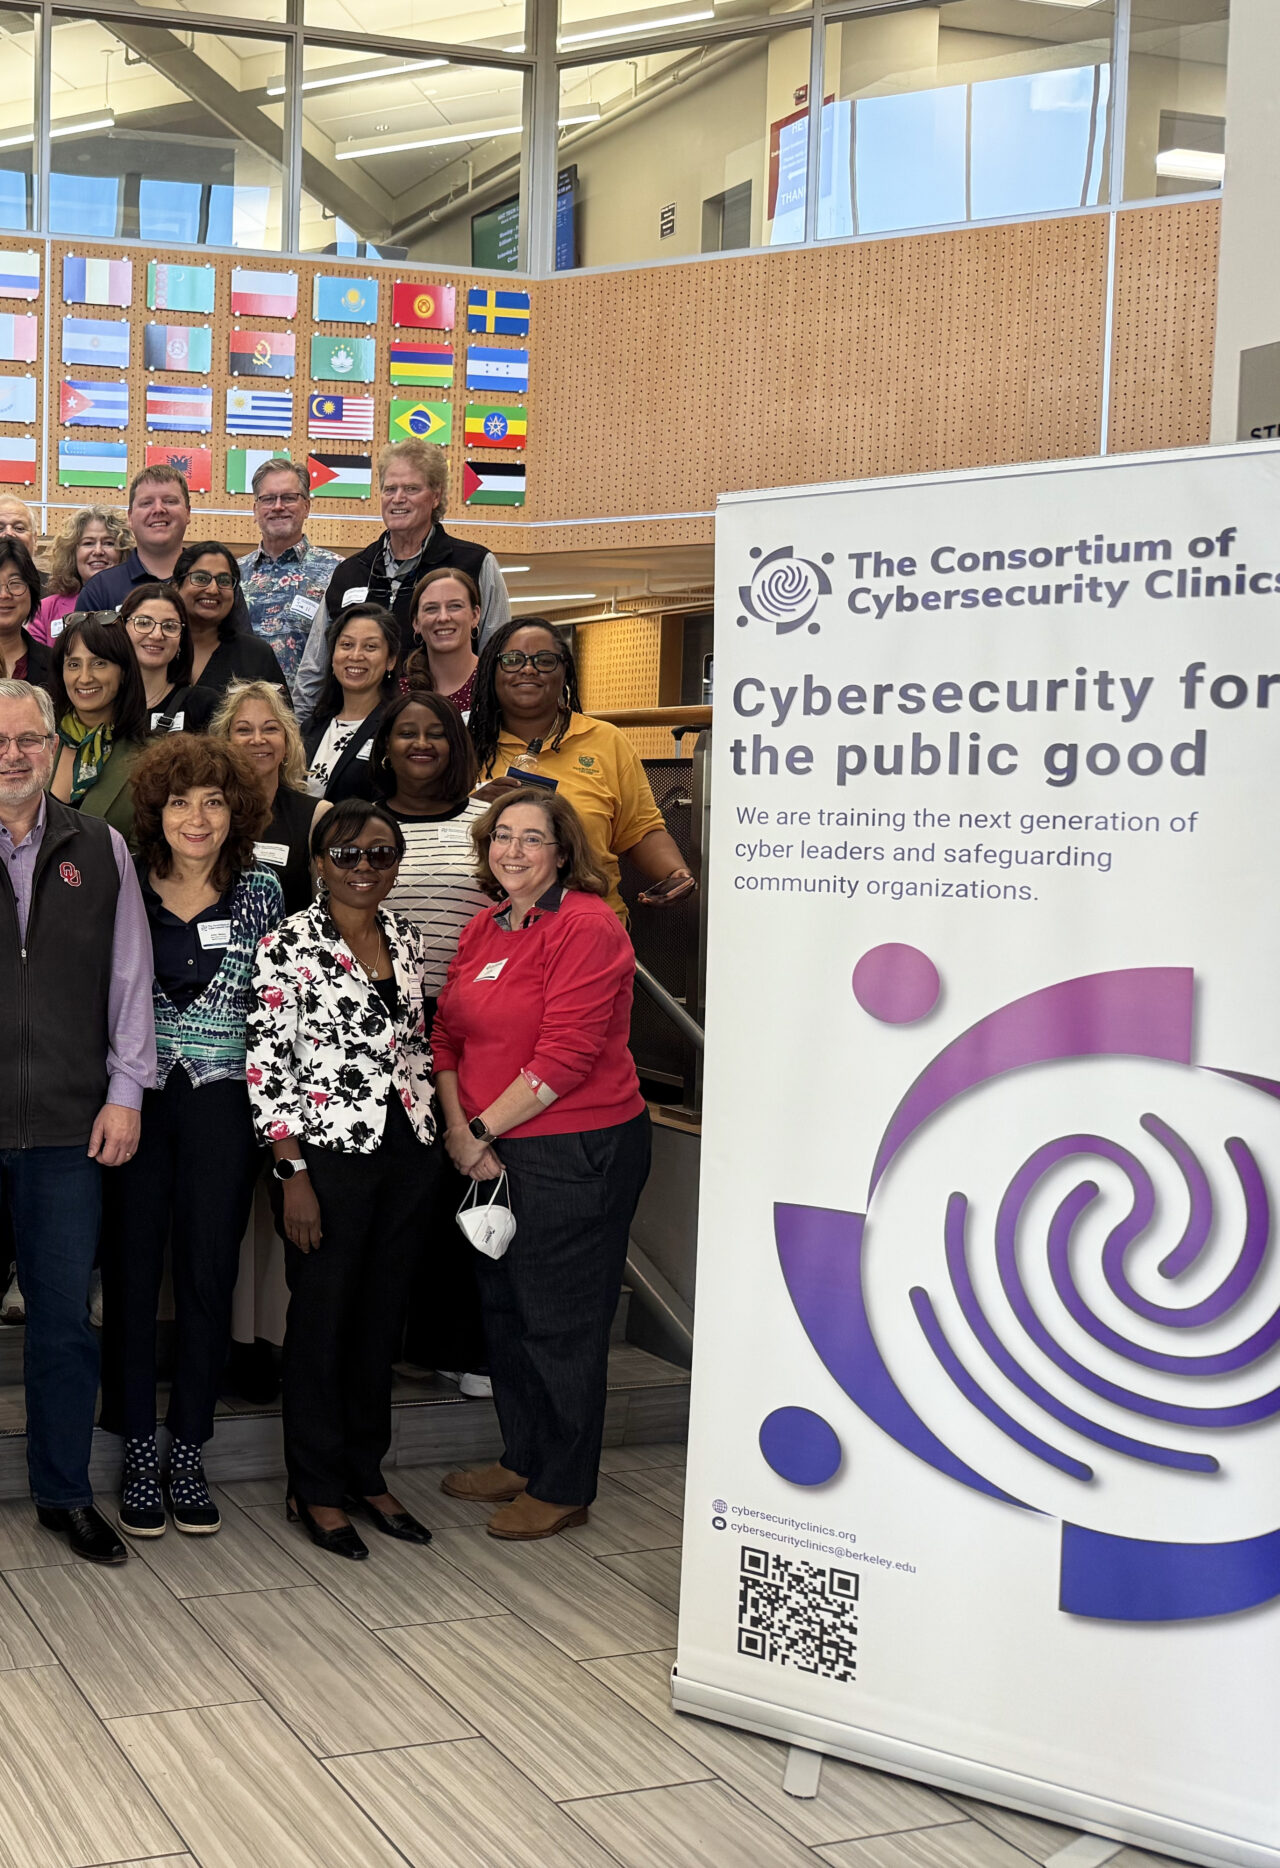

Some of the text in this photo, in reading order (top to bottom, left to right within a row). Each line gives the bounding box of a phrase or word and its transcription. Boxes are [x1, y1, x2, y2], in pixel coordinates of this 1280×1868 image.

[1250, 424, 1280, 440] ST
[847, 526, 1238, 580] The Consortium of
[847, 573, 1131, 620] Cybersecurity
[732, 661, 1280, 728] Cybersecurity for
[729, 728, 1208, 788] the public good
[735, 806, 1200, 835] We are training the next generation of
[735, 838, 1112, 873] cyber leaders and safeguarding
[733, 874, 1039, 901] community organizations.
[731, 1504, 857, 1544] cybersecurityclinics.org
[730, 1521, 917, 1574] cybersecurityclinics@berkeley.edu
